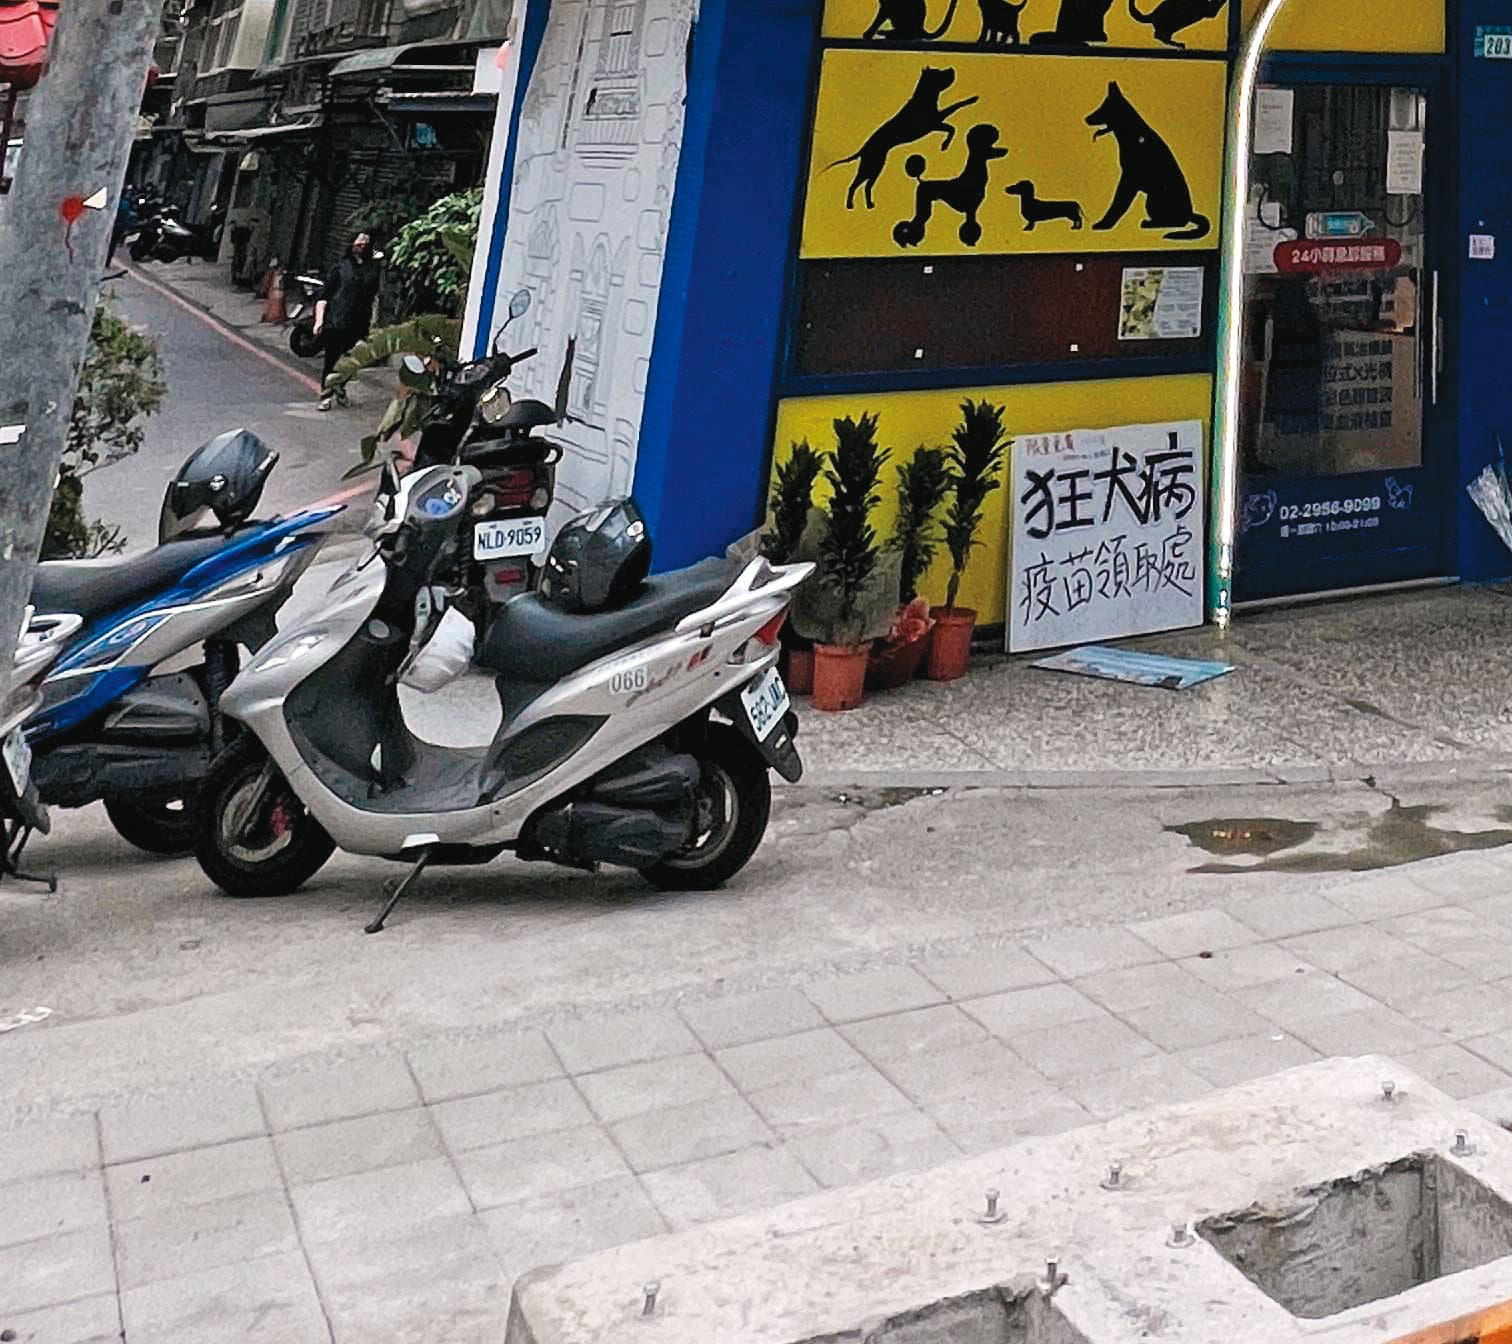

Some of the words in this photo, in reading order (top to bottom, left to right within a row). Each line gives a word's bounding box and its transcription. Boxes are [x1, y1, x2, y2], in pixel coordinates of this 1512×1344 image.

[1021, 431, 1196, 539] 狂犬病
[1019, 526, 1196, 626] 疫苗領取處
[611, 668, 645, 693] 066
